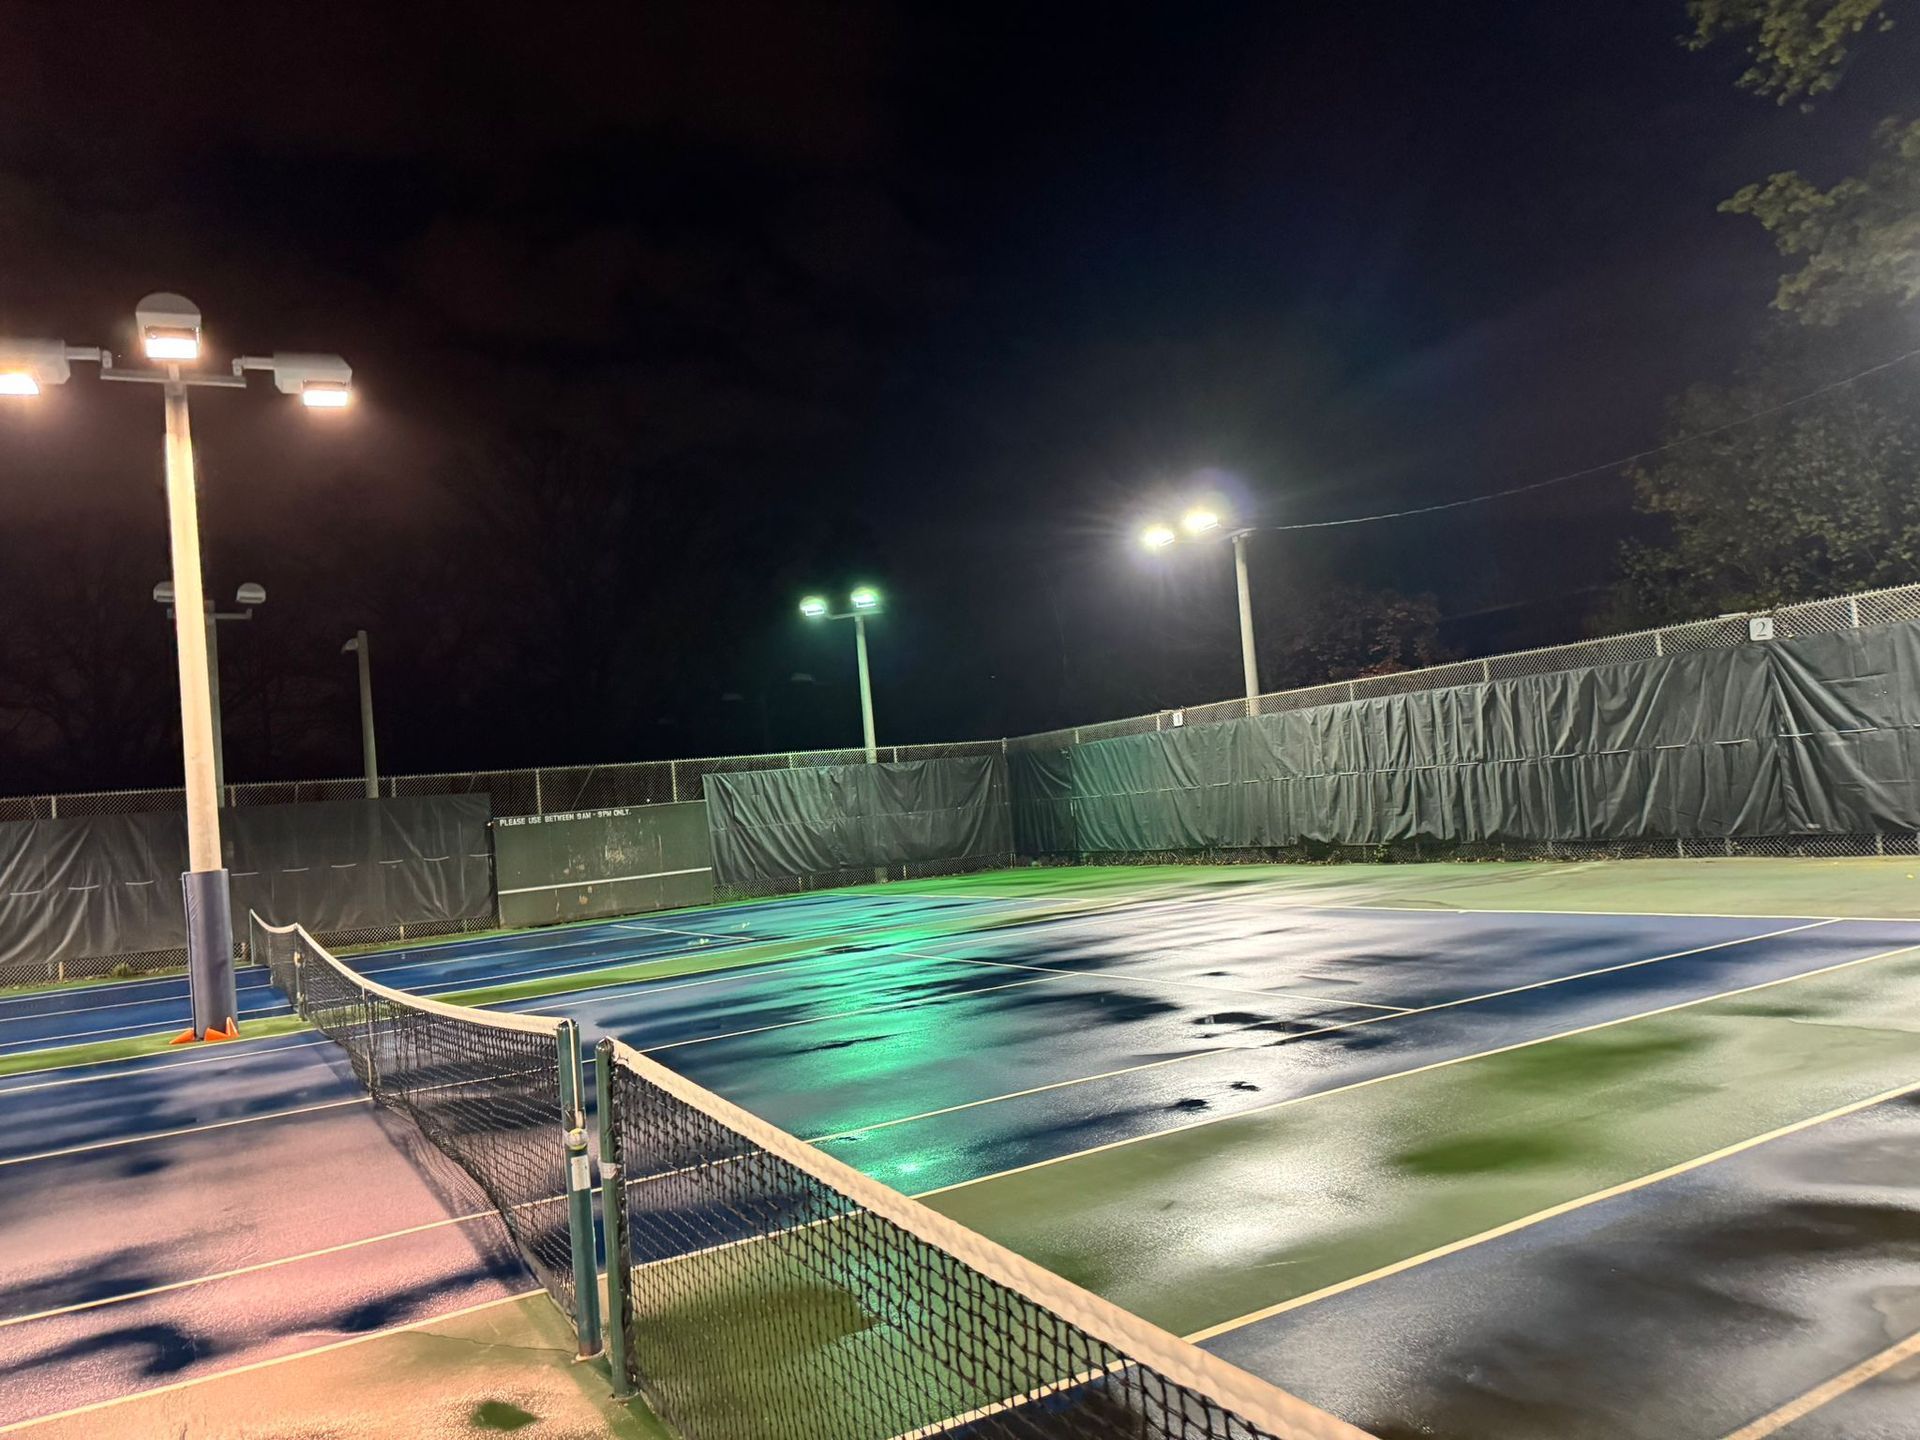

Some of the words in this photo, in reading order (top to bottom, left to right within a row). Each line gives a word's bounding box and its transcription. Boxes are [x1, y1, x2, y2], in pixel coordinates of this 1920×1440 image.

[1755, 621, 1767, 637] 2
[500, 817, 525, 827] PLEASE
[528, 816, 541, 824] USE
[544, 813, 574, 823] BETWEEN
